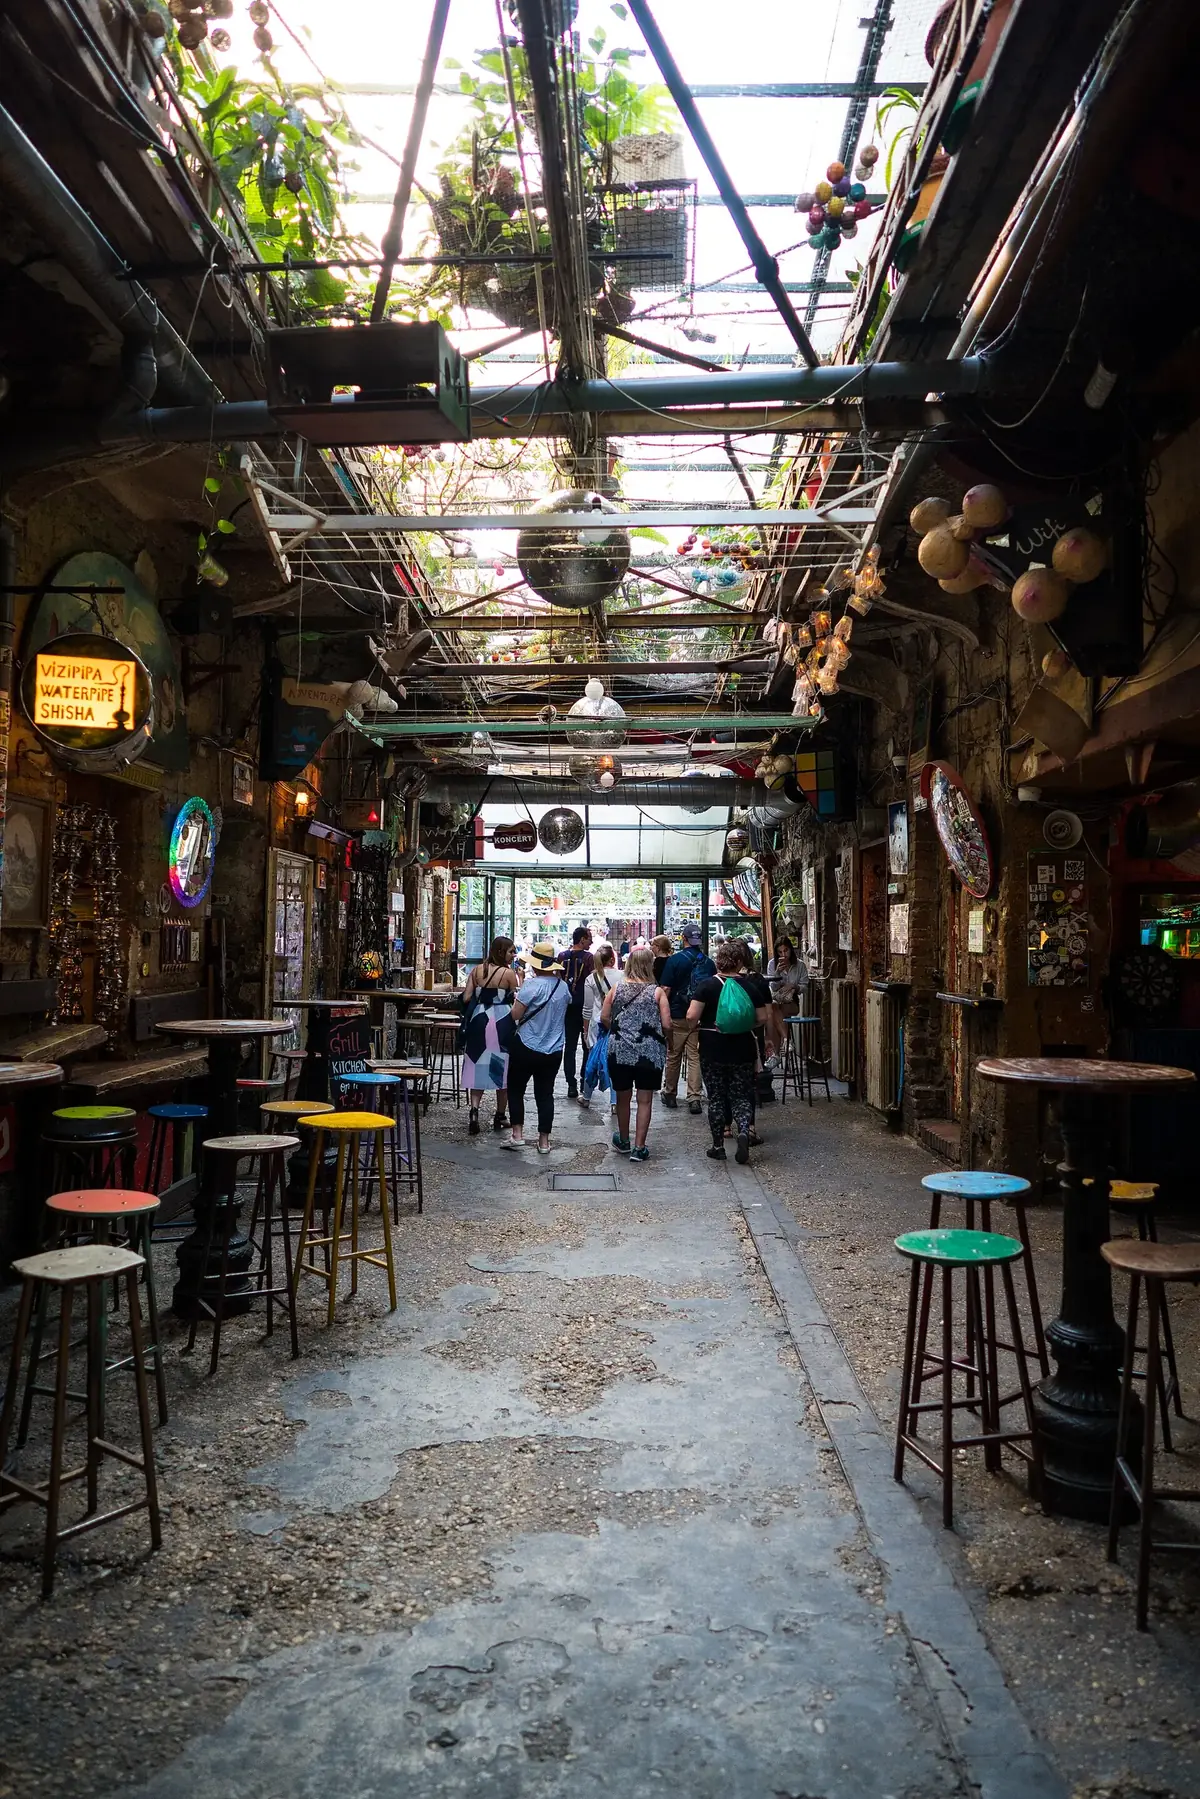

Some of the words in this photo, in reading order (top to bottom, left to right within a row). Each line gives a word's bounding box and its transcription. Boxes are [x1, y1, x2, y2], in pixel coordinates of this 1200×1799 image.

[494, 835, 533, 845] KONCERT
[330, 1032, 361, 1054] Grill
[332, 1060, 367, 1074] KITCHEN
